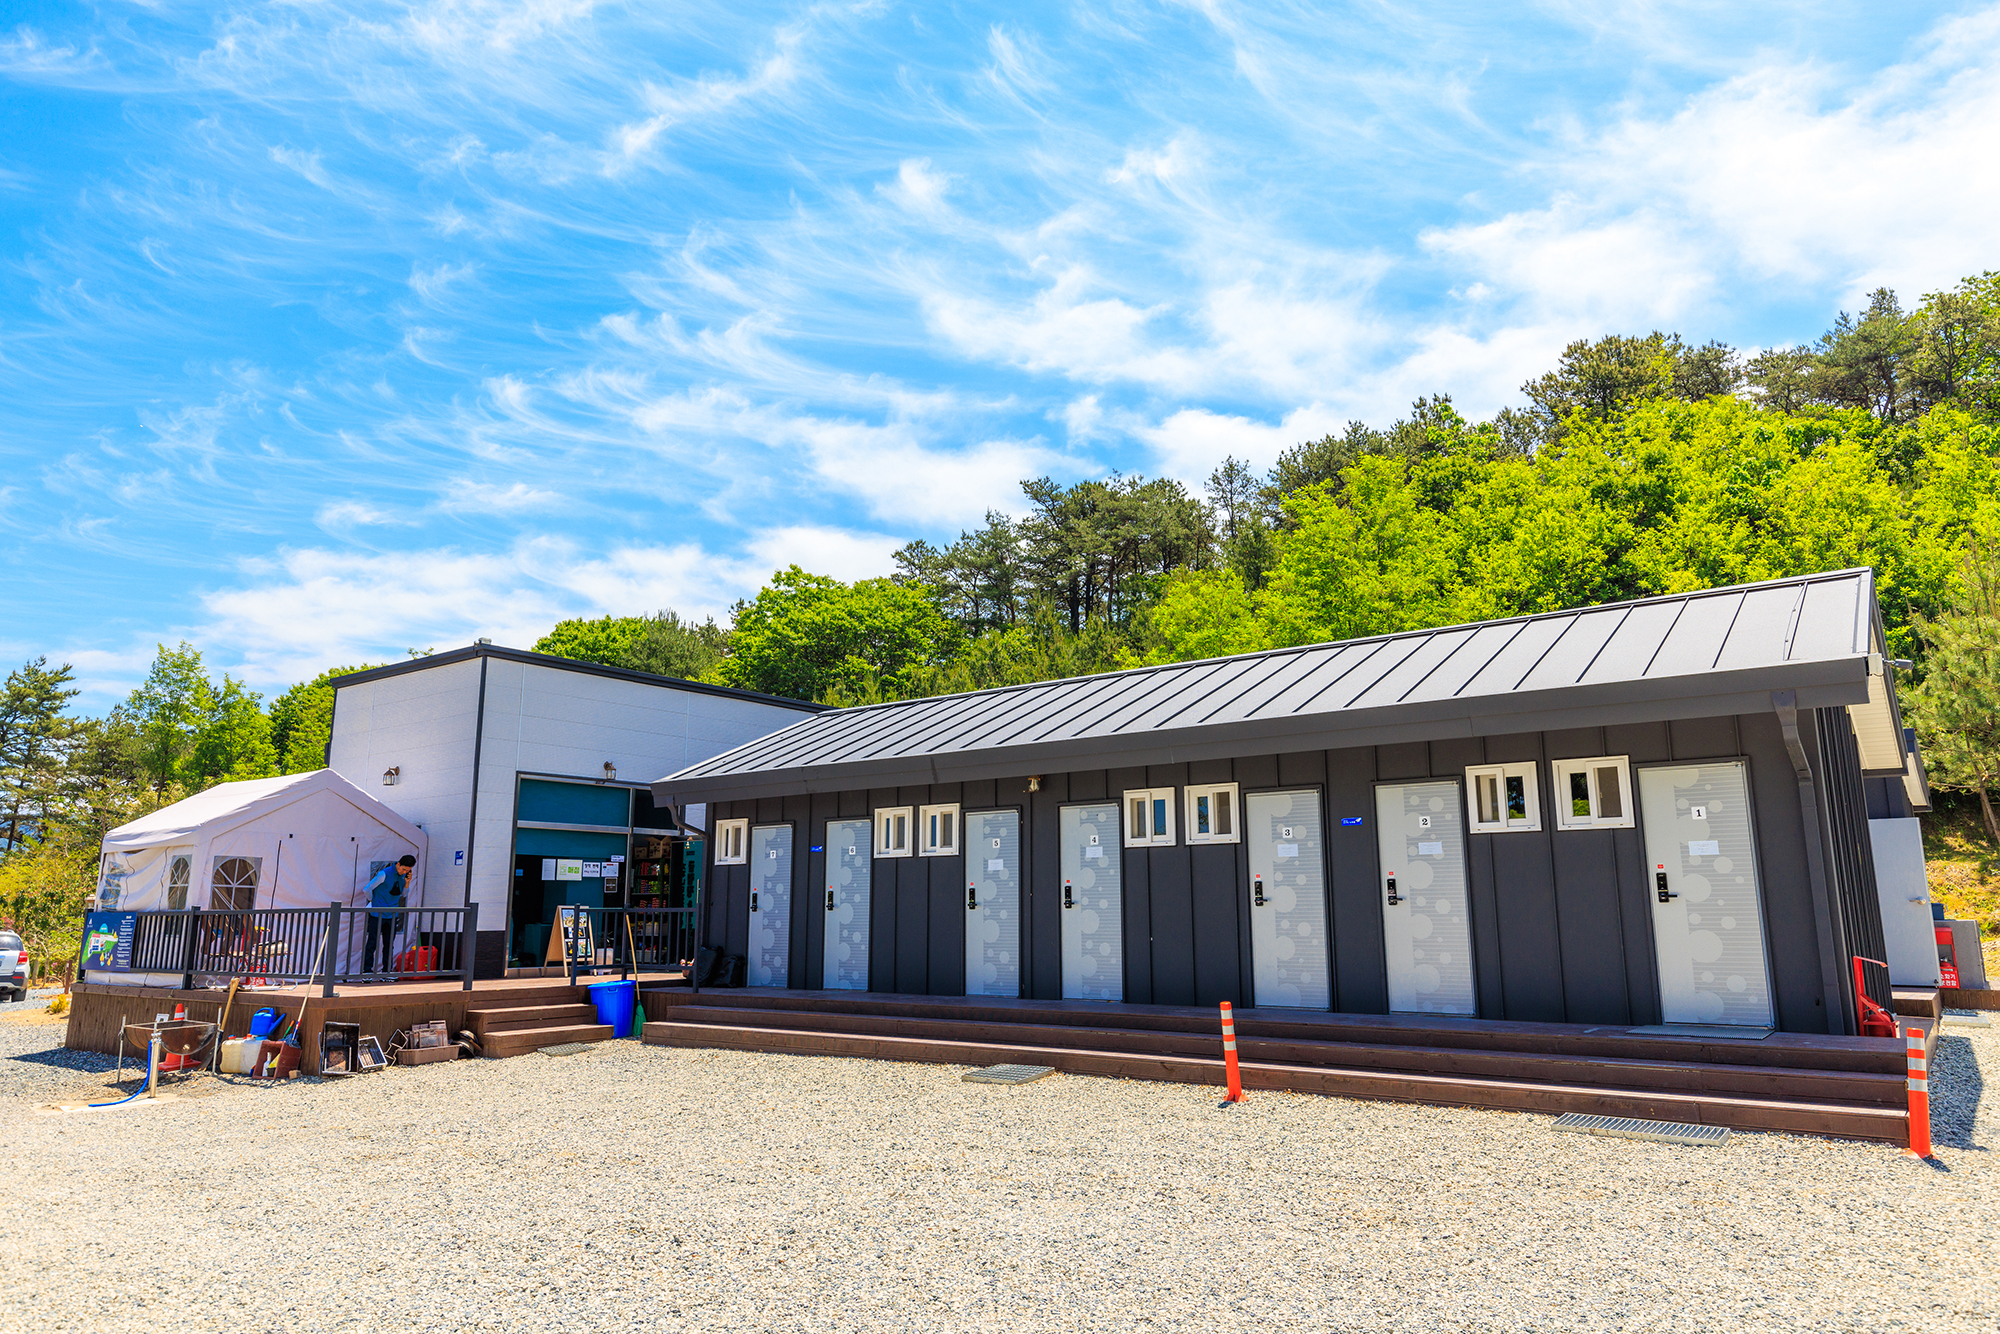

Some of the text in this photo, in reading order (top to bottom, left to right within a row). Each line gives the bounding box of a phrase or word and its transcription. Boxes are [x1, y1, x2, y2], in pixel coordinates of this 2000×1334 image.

[1696, 808, 1702, 818] 1
[1422, 818, 1428, 826] 2
[1284, 828, 1290, 836] 3
